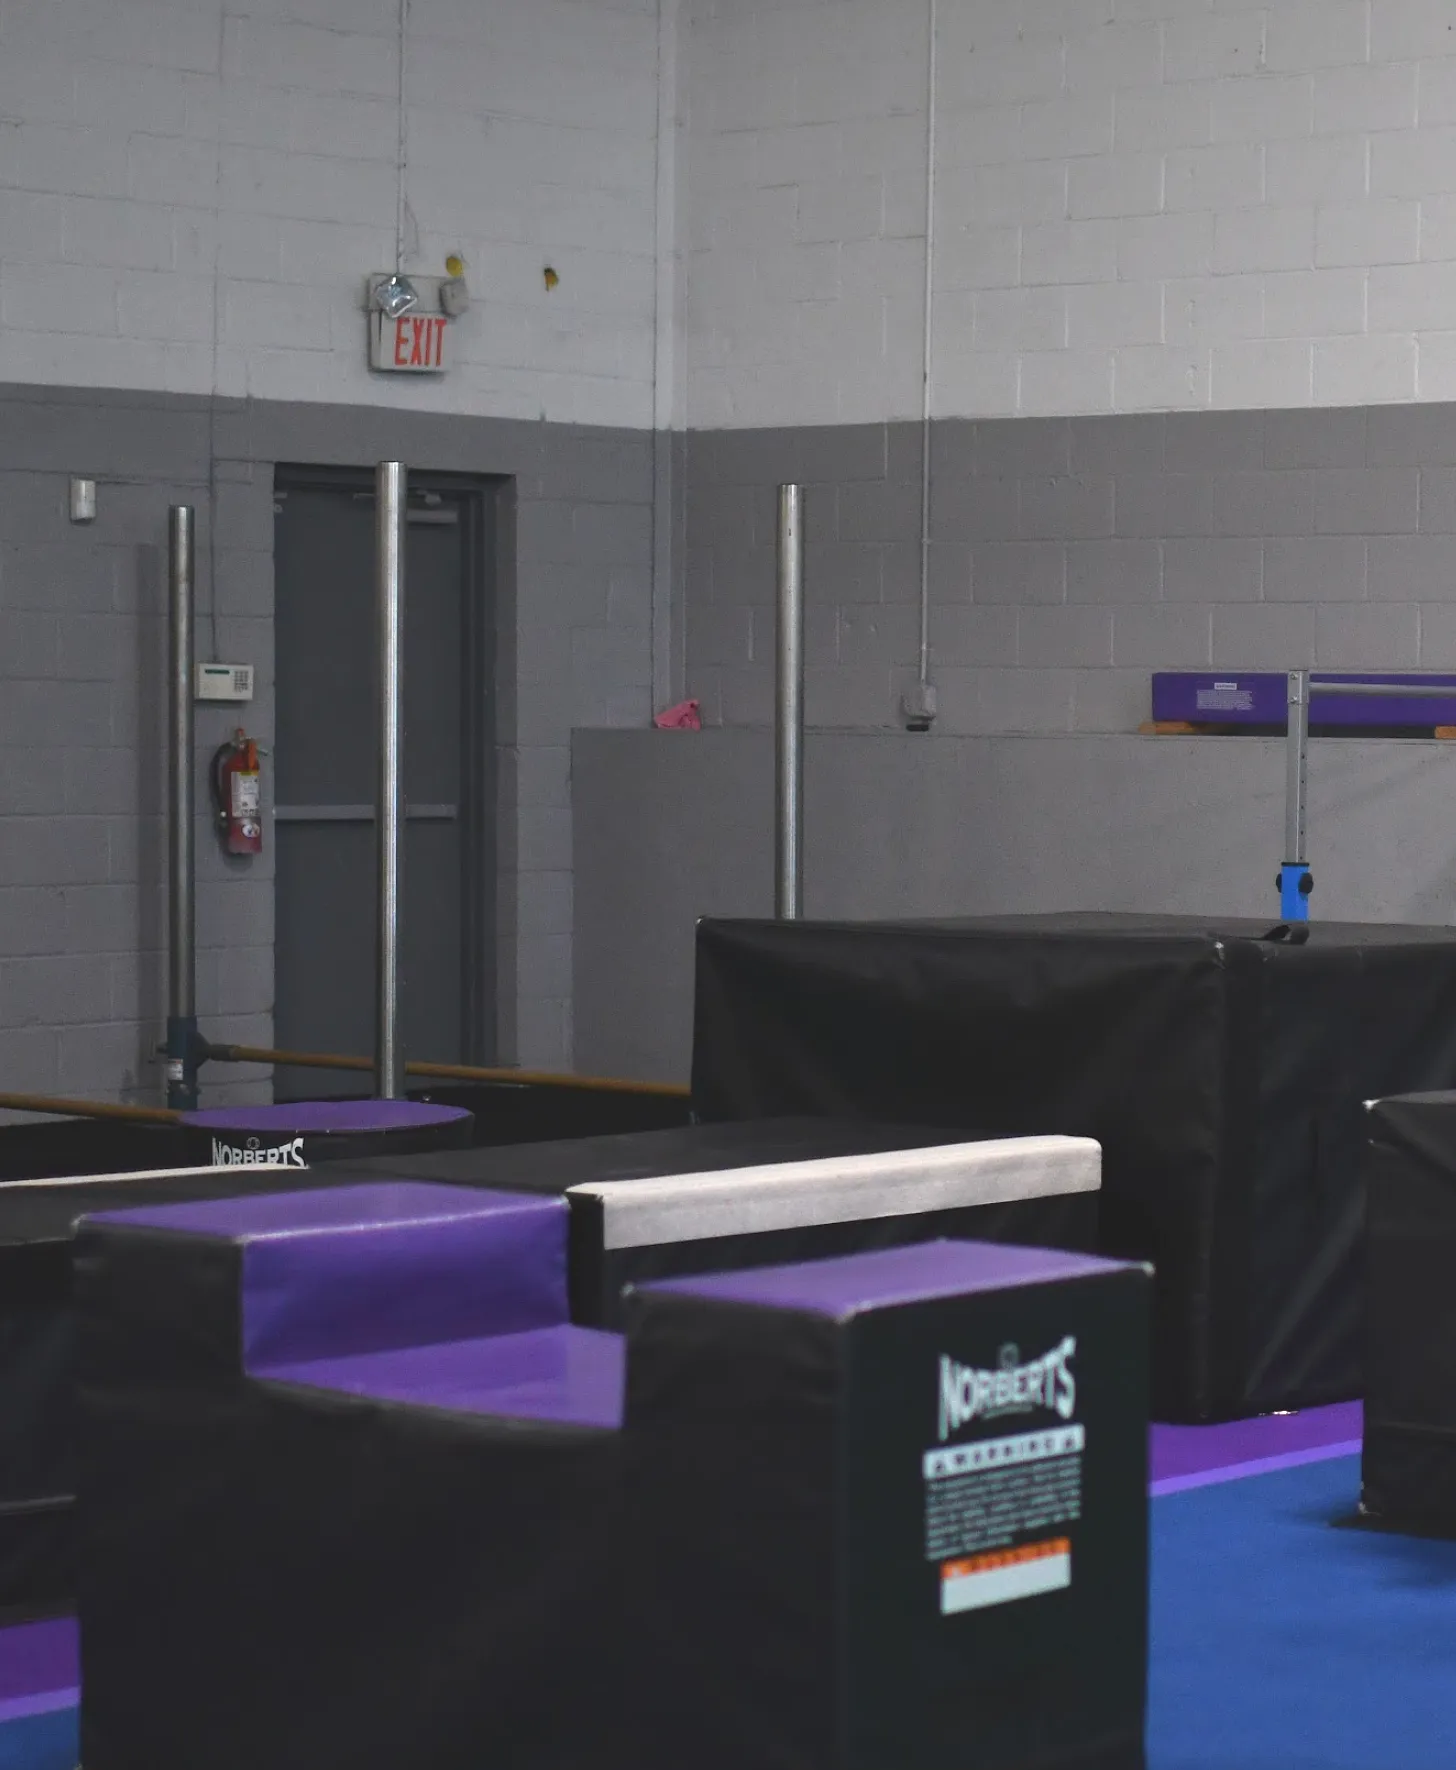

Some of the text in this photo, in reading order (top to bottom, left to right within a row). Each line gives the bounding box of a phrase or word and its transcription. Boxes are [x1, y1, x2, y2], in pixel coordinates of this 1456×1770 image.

[394, 317, 447, 366] EXIT
[211, 1136, 306, 1168] NORBERTS
[937, 1334, 1077, 1442] NORBERTS
